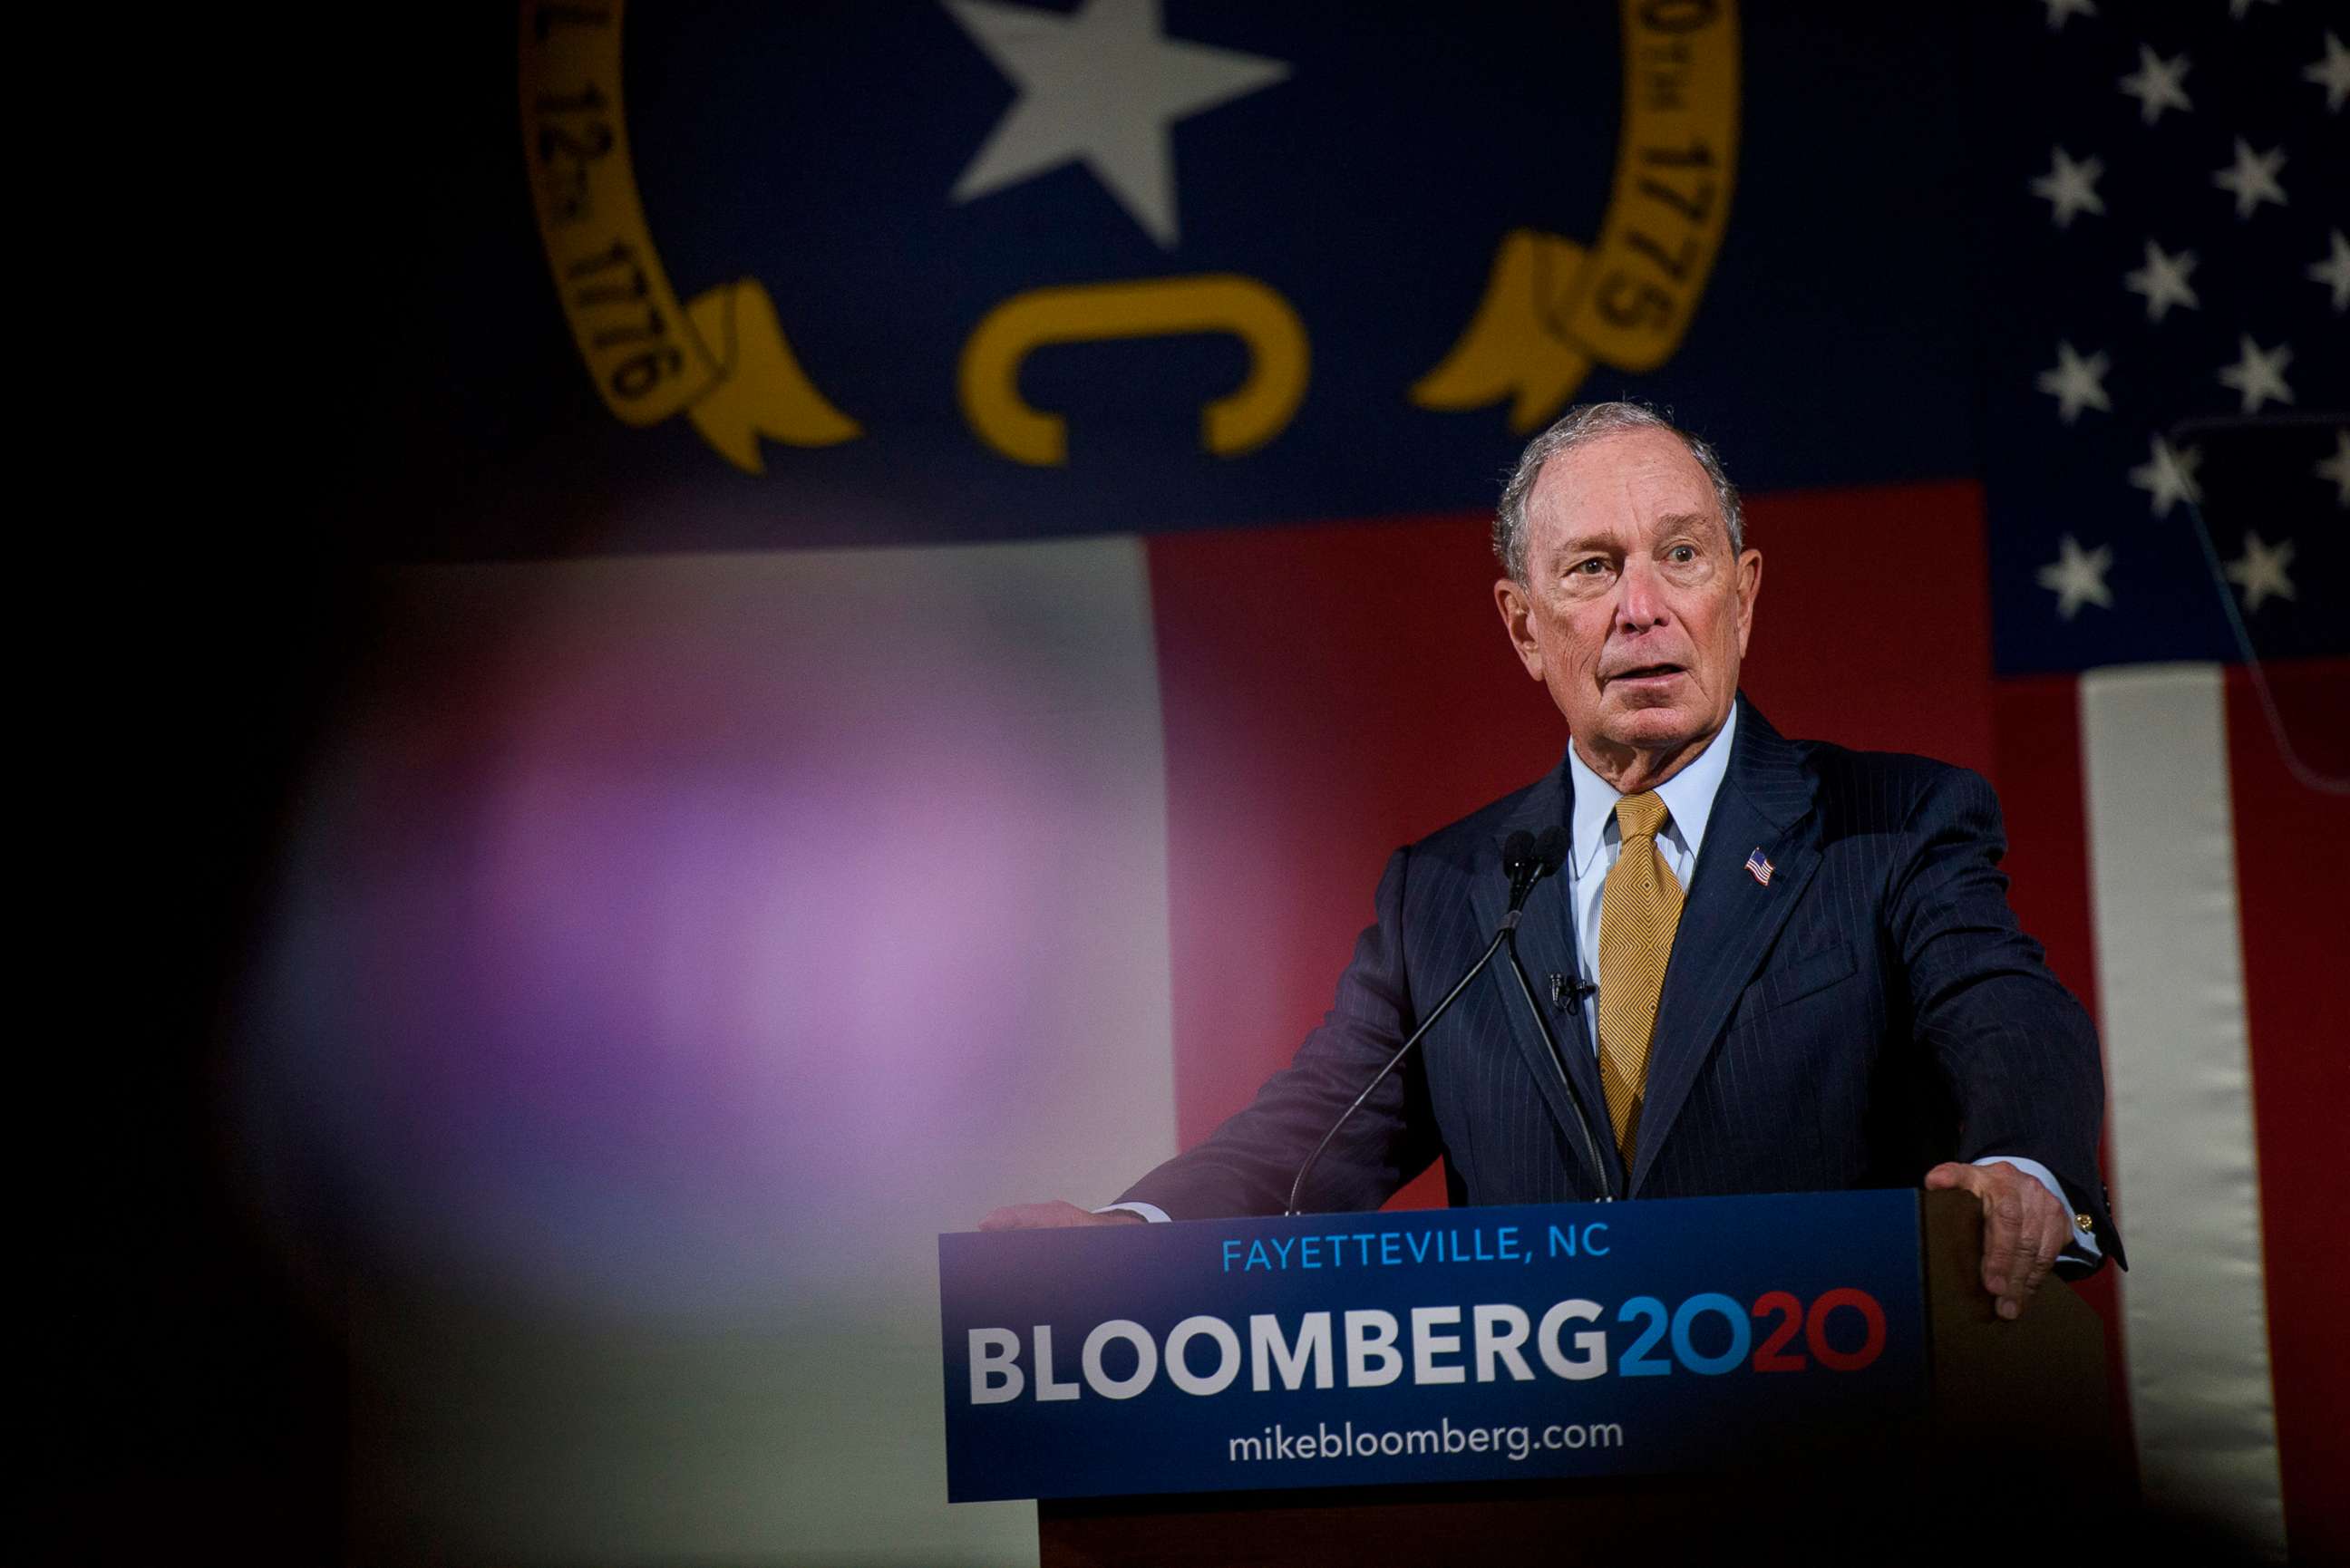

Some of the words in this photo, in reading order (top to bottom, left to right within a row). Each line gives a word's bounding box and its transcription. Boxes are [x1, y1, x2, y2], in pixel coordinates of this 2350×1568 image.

[1596, 142, 1715, 330] 1775
[564, 237, 685, 402] 1776
[956, 270, 1313, 469] C
[1221, 1227, 1533, 1272] FAYETTEVILLE,
[1548, 1223, 1611, 1258] NC
[1228, 1418, 1624, 1461] mikebloomberg.com
